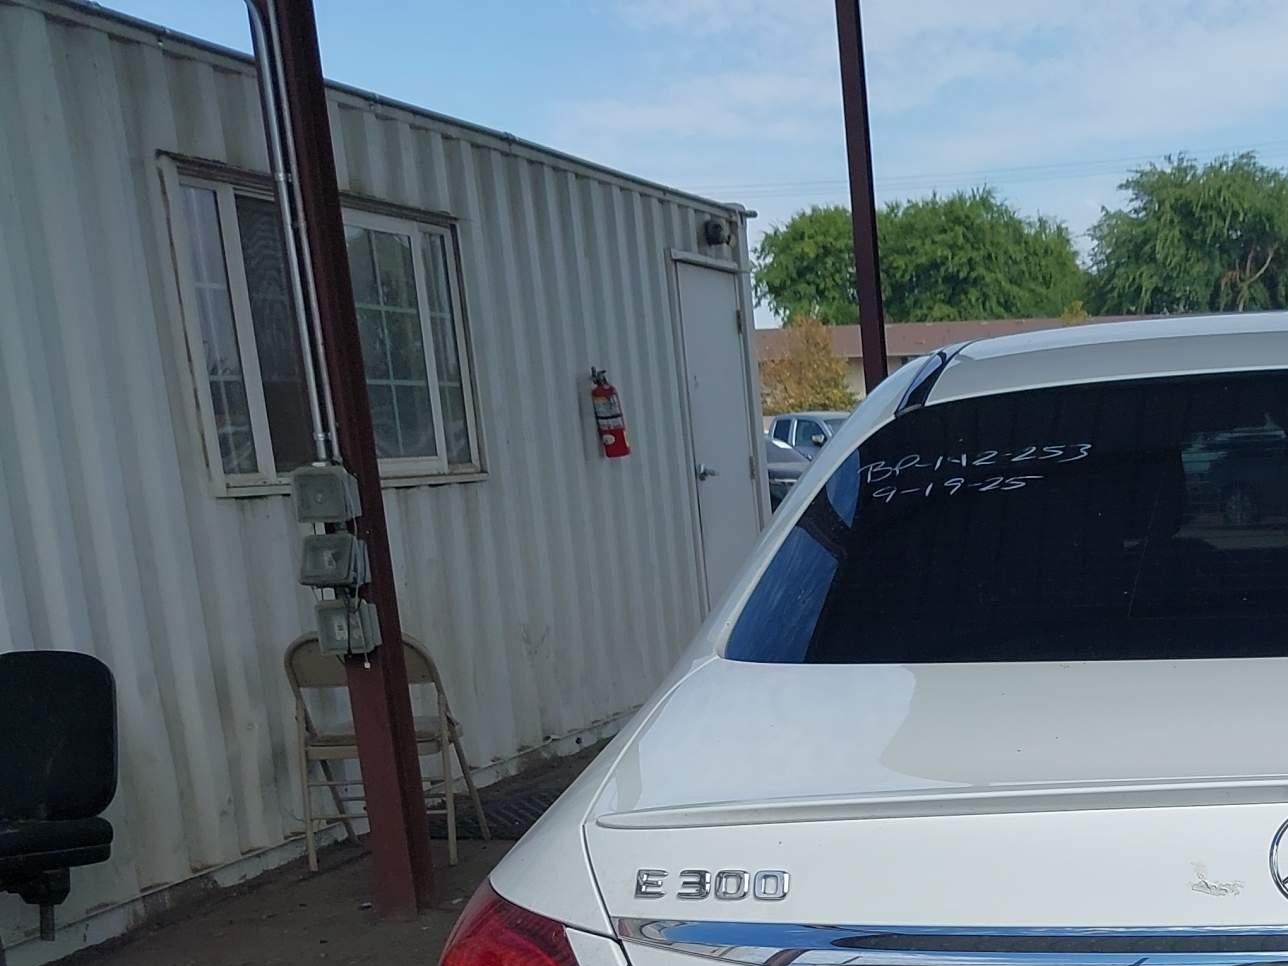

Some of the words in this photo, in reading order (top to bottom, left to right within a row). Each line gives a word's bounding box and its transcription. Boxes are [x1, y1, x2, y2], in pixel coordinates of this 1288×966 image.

[873, 475, 1044, 502] 9-19-25
[635, 869, 669, 900] E
[676, 869, 791, 901] 300
